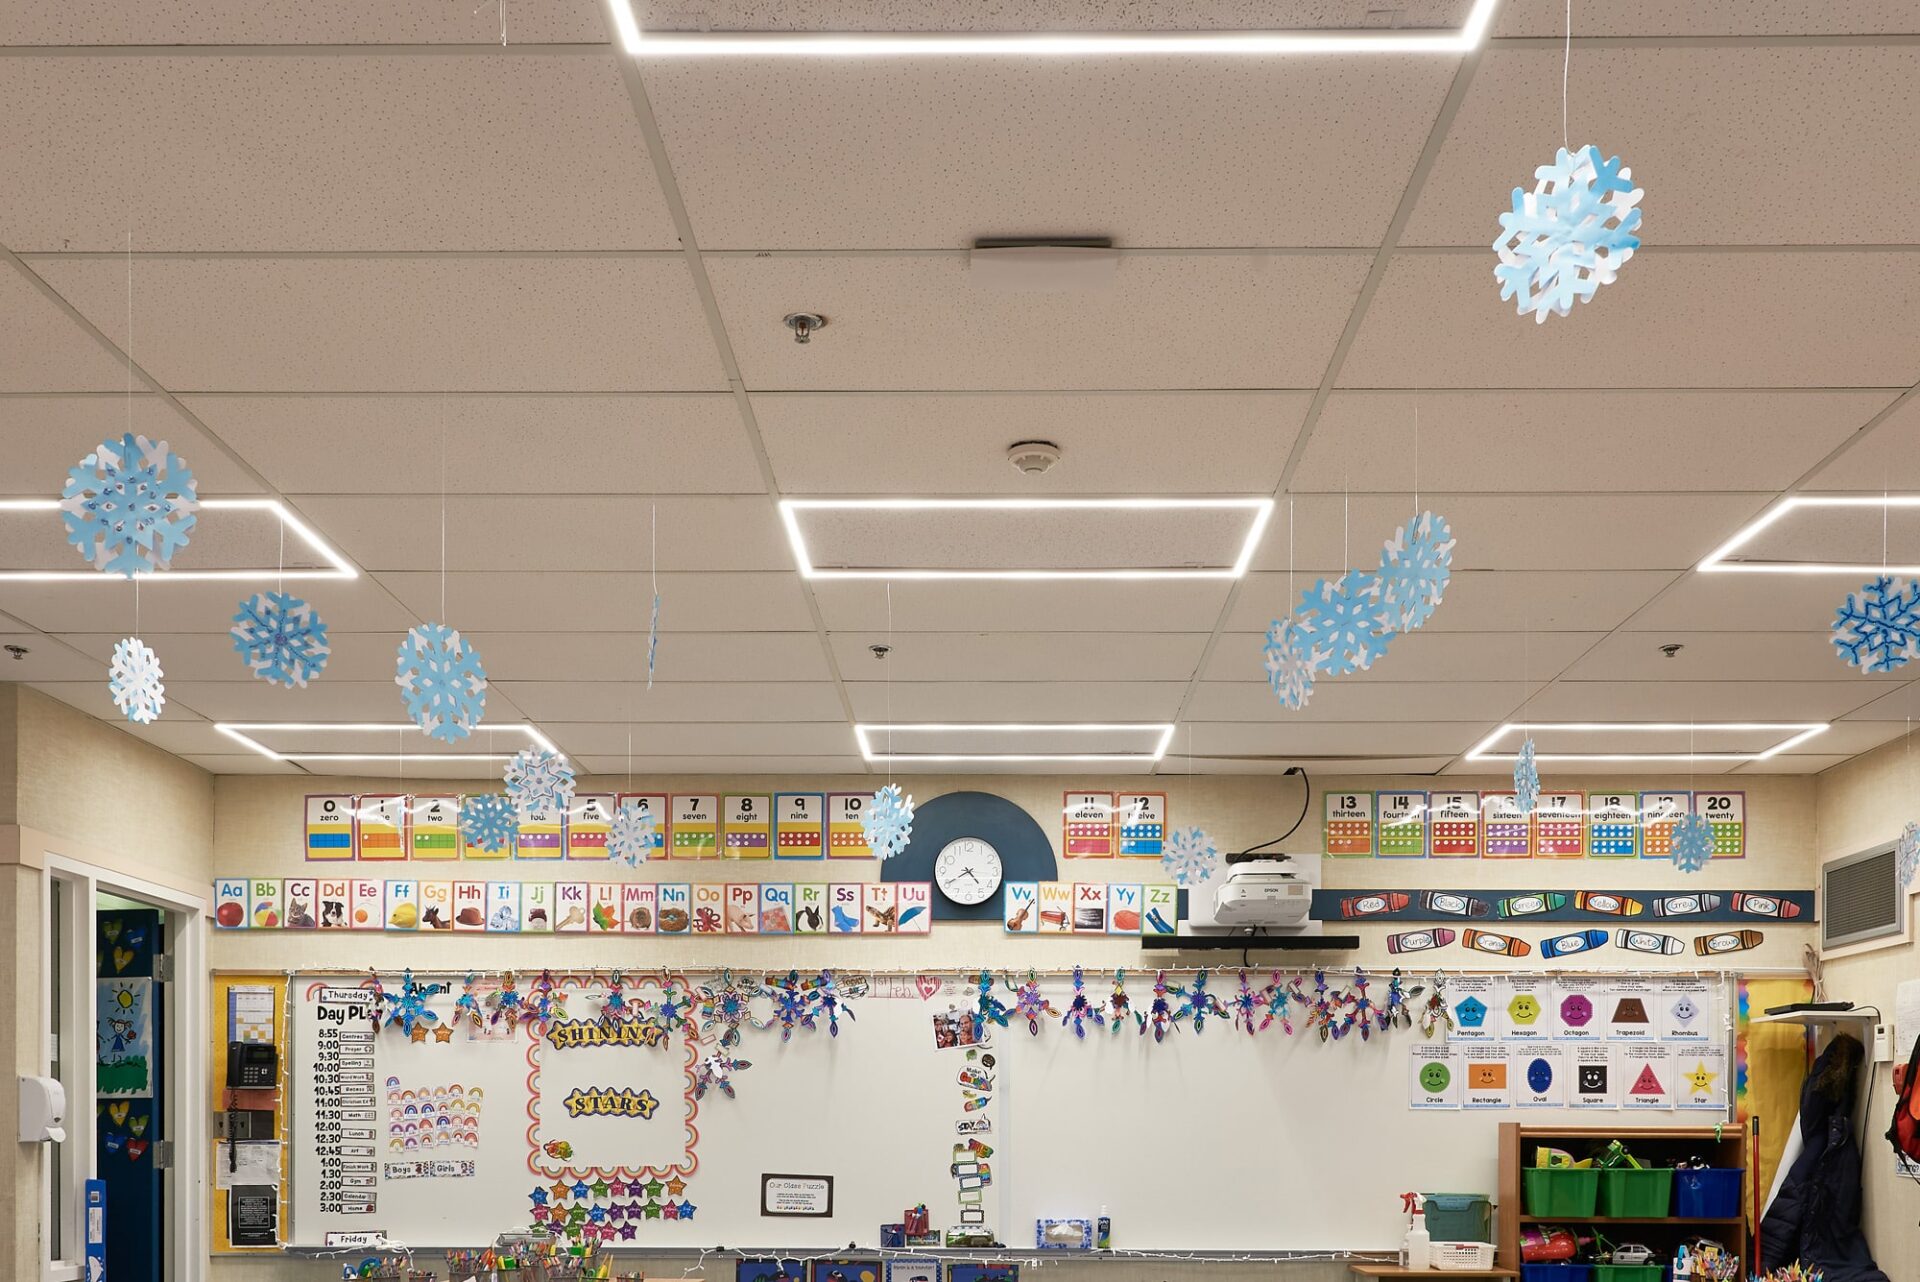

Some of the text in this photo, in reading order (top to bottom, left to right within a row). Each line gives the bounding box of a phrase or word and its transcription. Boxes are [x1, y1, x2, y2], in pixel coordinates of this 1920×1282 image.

[323, 800, 336, 813] 0
[430, 799, 441, 813] 2
[586, 799, 597, 811] 5
[637, 798, 649, 811] 6
[689, 798, 700, 811] 7
[741, 798, 753, 811] 8
[794, 798, 805, 811] 9
[844, 798, 862, 811] 10
[1134, 797, 1150, 811] 12
[1340, 796, 1357, 809] 13
[1393, 796, 1409, 809] 14
[1446, 796, 1462, 809] 15
[1551, 796, 1568, 808] 17
[1604, 796, 1621, 809] 18
[1707, 796, 1731, 810] 20
[427, 814, 443, 822] two
[582, 813, 600, 821] five
[736, 812, 758, 822] eight
[790, 812, 808, 820] nine
[1075, 810, 1104, 819] eleven
[1332, 810, 1366, 818] thirteen
[1440, 810, 1469, 818] fifteen
[1594, 811, 1631, 821] eighteen
[1705, 812, 1735, 821] twenty
[953, 845, 961, 856] 11
[964, 841, 974, 852] 12
[944, 855, 955, 865] 10
[987, 854, 995, 864] 2
[939, 866, 946, 876] 9
[992, 866, 999, 877] 3
[986, 879, 993, 888] 4
[221, 883, 243, 897] Aa
[256, 883, 276, 897] Bb
[290, 883, 310, 897] Cc
[323, 883, 345, 896] Dd
[359, 884, 377, 897] Ee
[394, 884, 410, 897] Ff
[424, 885, 447, 901] Gg
[458, 885, 481, 899] Hh
[498, 886, 510, 899] Ii
[530, 886, 544, 903] Jj
[562, 886, 582, 900] Kk
[600, 886, 612, 900] Ll
[626, 888, 654, 901] Mm
[663, 888, 685, 901] Nn
[697, 888, 720, 901] Oo
[803, 888, 820, 901] Rr
[836, 888, 855, 901] Ss
[871, 887, 888, 901] Tt
[903, 887, 925, 901] Uu
[953, 888, 960, 897] 7
[977, 888, 985, 899] 5
[1012, 886, 1032, 900] Vv
[1042, 887, 1070, 900] Ww
[1080, 887, 1102, 900] Xx
[732, 888, 753, 904] Pp
[765, 888, 790, 905] Qq
[965, 891, 973, 901] 6
[1116, 888, 1135, 905] Yy
[1151, 889, 1170, 903] Zz
[1362, 899, 1380, 910] Red
[1440, 897, 1461, 908] Black
[1514, 900, 1539, 909] Green
[1592, 898, 1617, 909] Yellow
[1670, 900, 1693, 910] Grey
[1753, 899, 1770, 910] Pink
[1404, 935, 1432, 948] Purple
[1479, 936, 1506, 948] Orange
[1560, 939, 1580, 950] Blue
[1632, 937, 1657, 947] White
[1712, 938, 1738, 948] Brown
[410, 981, 452, 995] Abnt
[328, 990, 368, 1000] Thursday
[317, 1005, 345, 1025] Day
[318, 1029, 338, 1038] 8:55
[557, 1026, 656, 1043] SHINING
[1456, 1029, 1485, 1037] Pentagon
[1615, 1029, 1646, 1037] Trapezoid
[317, 1040, 339, 1050] 9:00
[318, 1052, 340, 1061] 9:30
[313, 1063, 340, 1072] 10:00
[313, 1074, 340, 1084] 10:30
[314, 1086, 340, 1096] 10:45
[315, 1098, 340, 1107] 11:00
[575, 1096, 649, 1112] STARS
[315, 1110, 340, 1120] 11:30
[315, 1121, 341, 1131] 12:00
[315, 1134, 341, 1143] 12:30
[315, 1146, 341, 1156] 12:45
[320, 1157, 341, 1167] 1:00
[392, 1166, 411, 1174] Boys
[436, 1164, 455, 1172] Girls
[320, 1180, 341, 1190] 2:00
[320, 1191, 341, 1201] 2:30
[320, 1202, 341, 1212] 3:00
[340, 1235, 368, 1244] Friday
